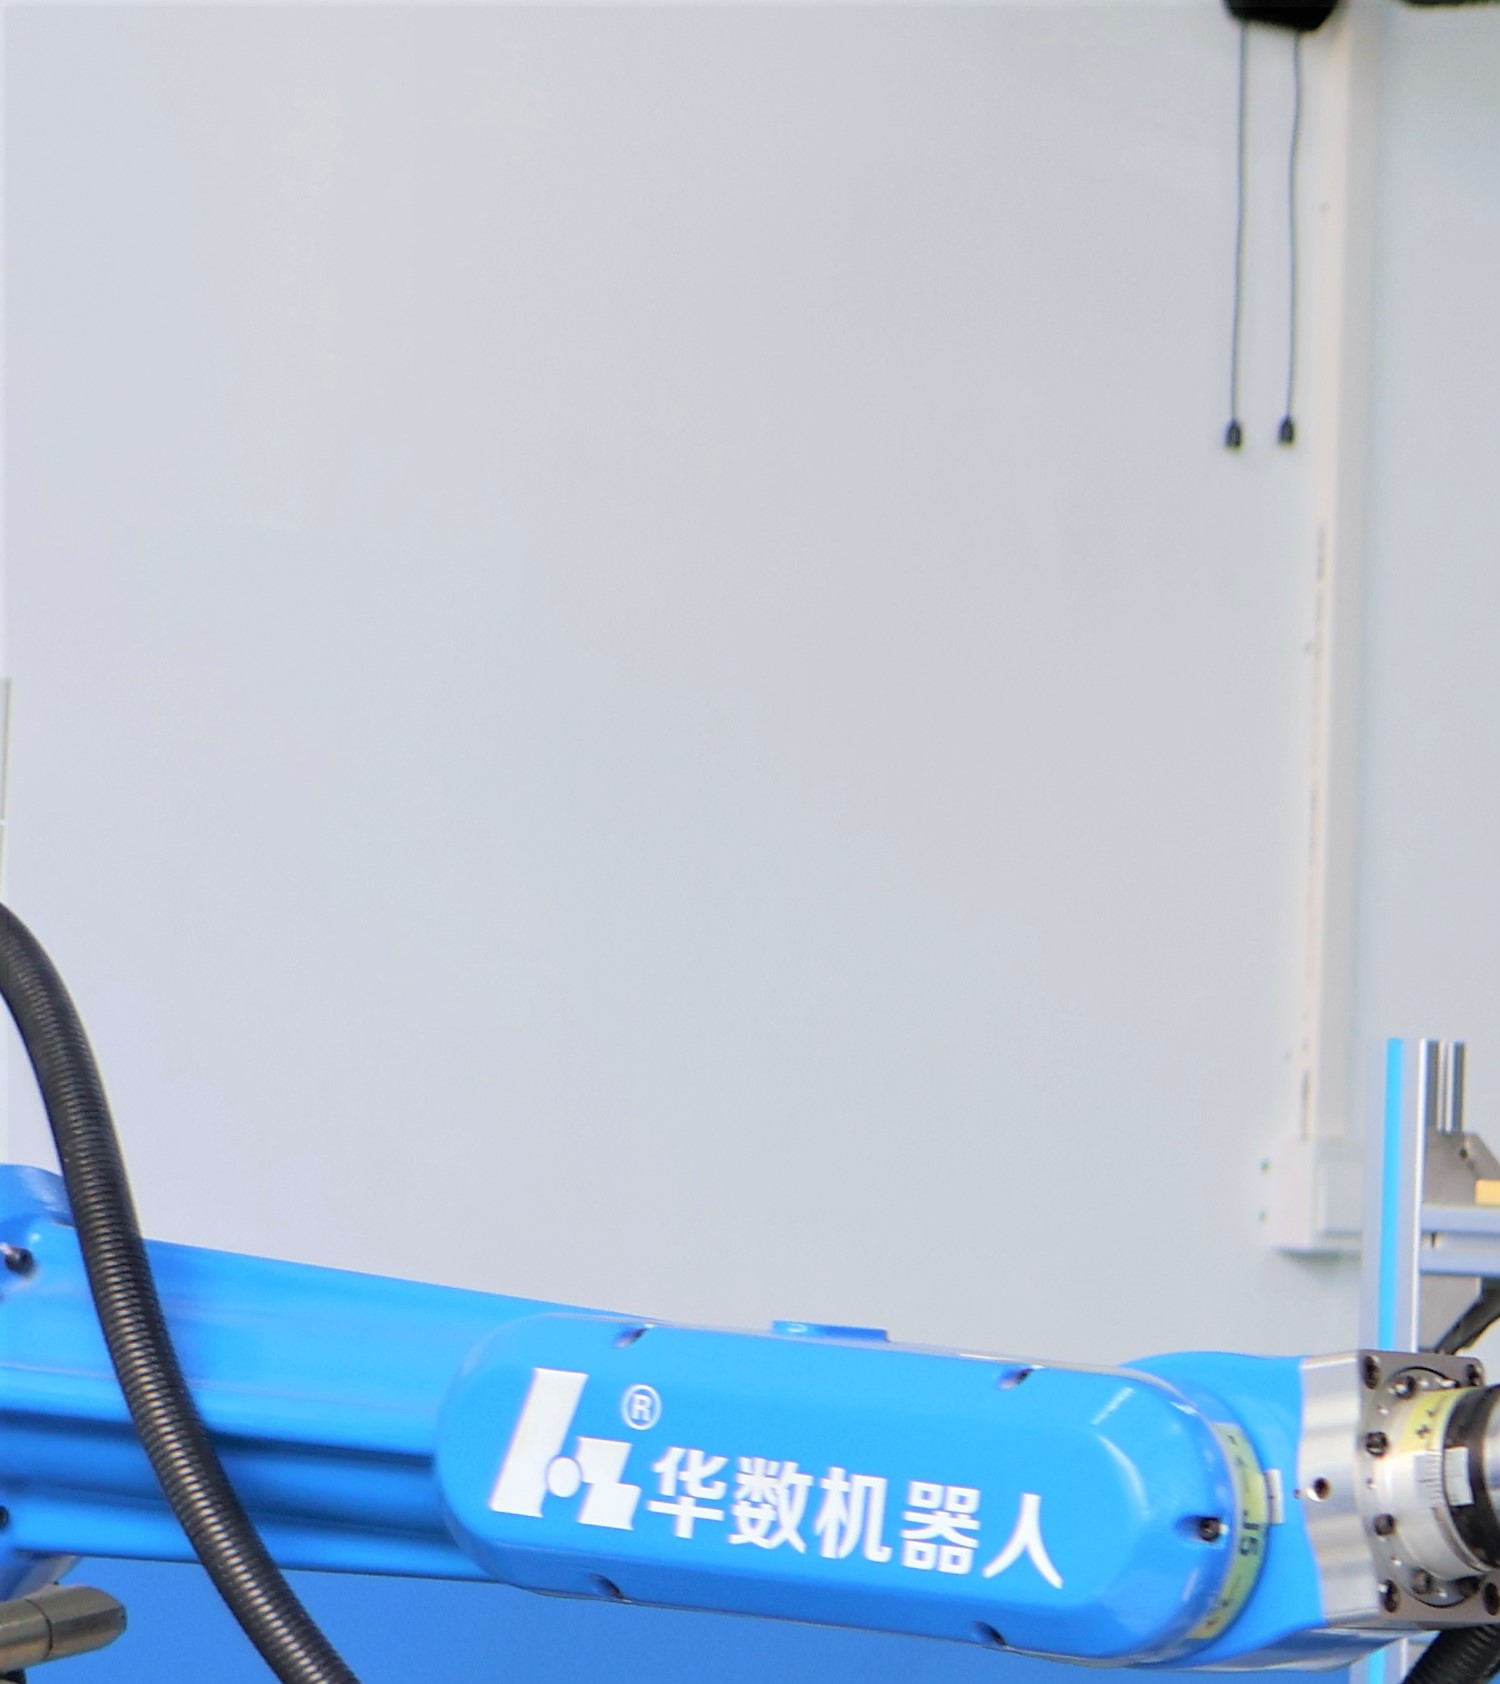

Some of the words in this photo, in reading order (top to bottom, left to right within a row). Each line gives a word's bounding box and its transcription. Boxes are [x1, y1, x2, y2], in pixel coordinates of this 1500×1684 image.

[646, 1446, 1064, 1589] 华数机器人
